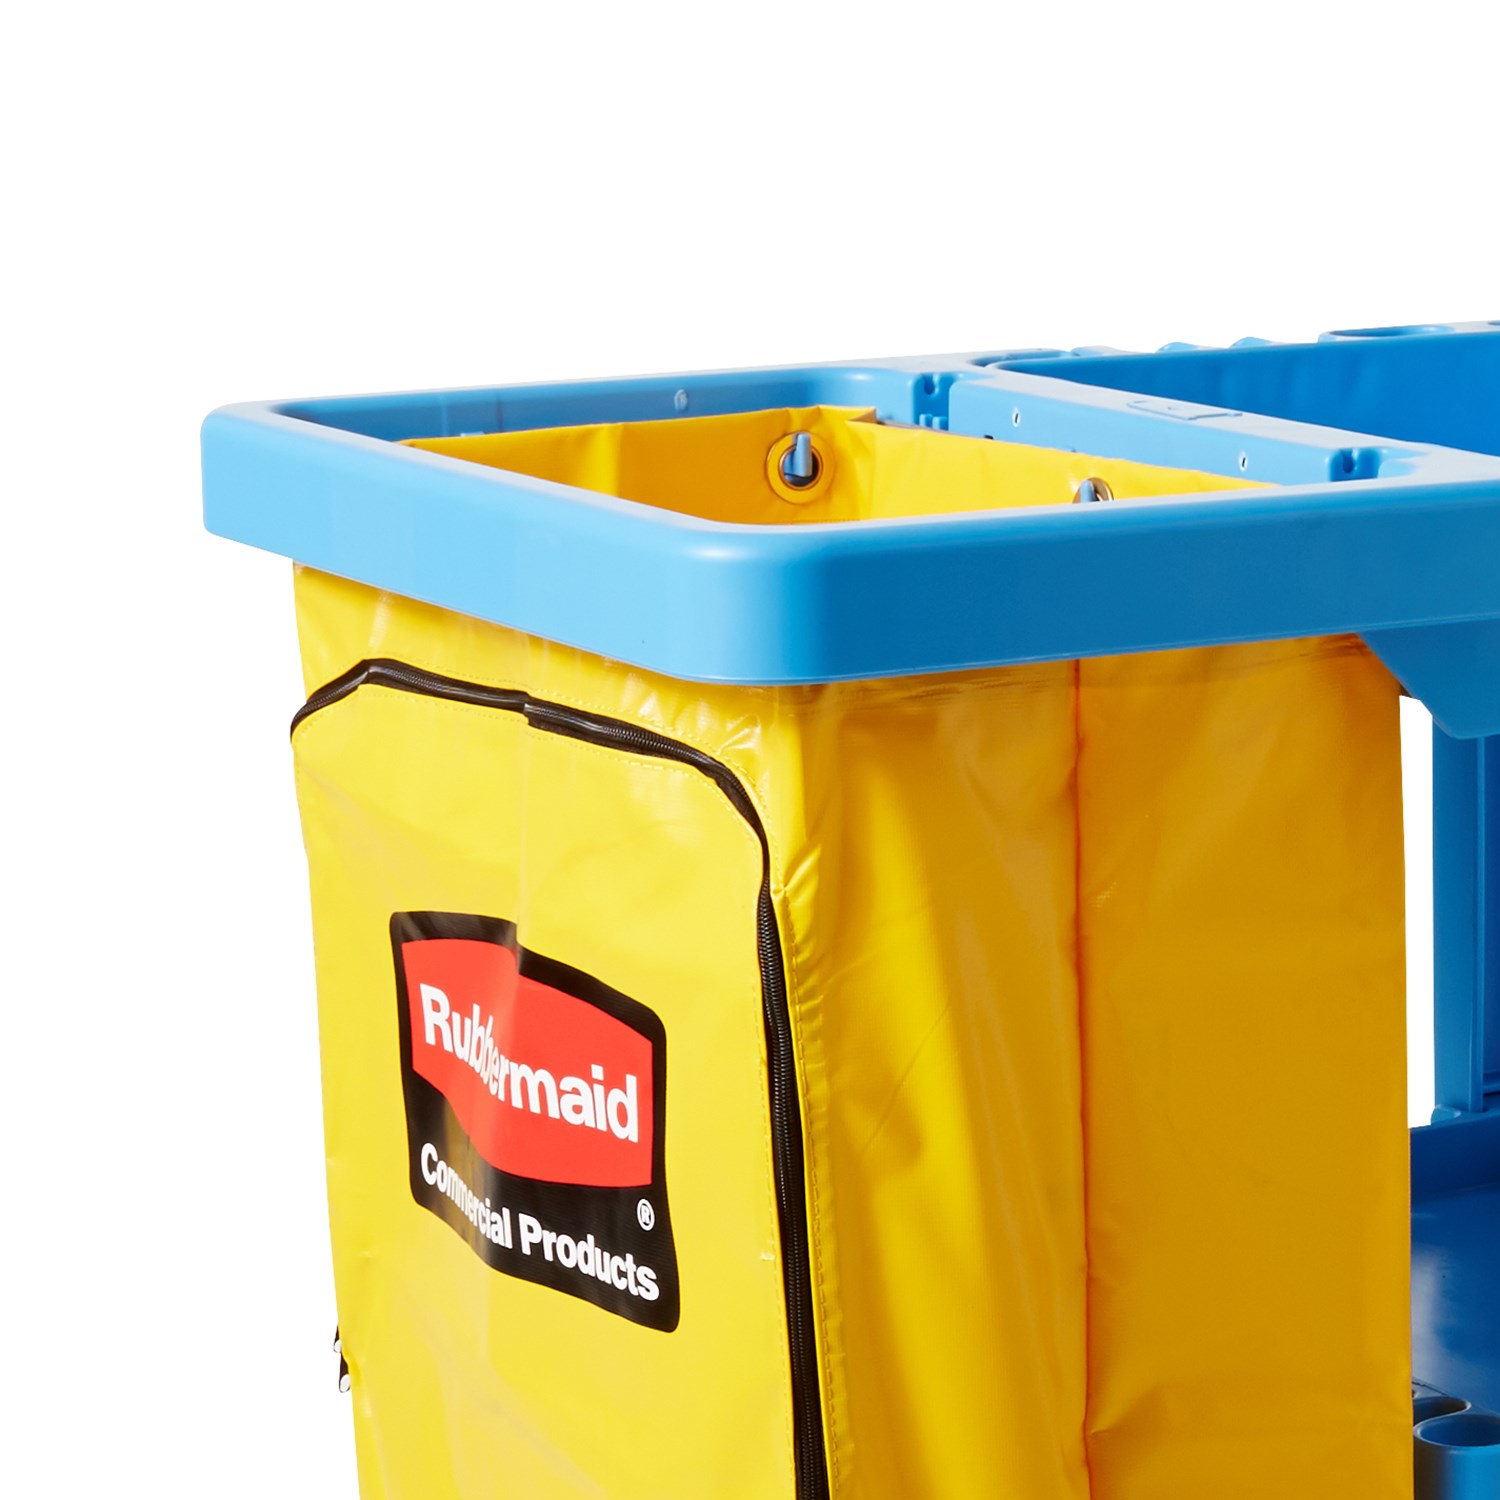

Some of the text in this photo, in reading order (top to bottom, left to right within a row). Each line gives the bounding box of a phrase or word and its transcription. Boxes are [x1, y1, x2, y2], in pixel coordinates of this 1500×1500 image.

[420, 983, 639, 1143] Rubbermaid
[420, 1142, 660, 1301] Commercial Products
